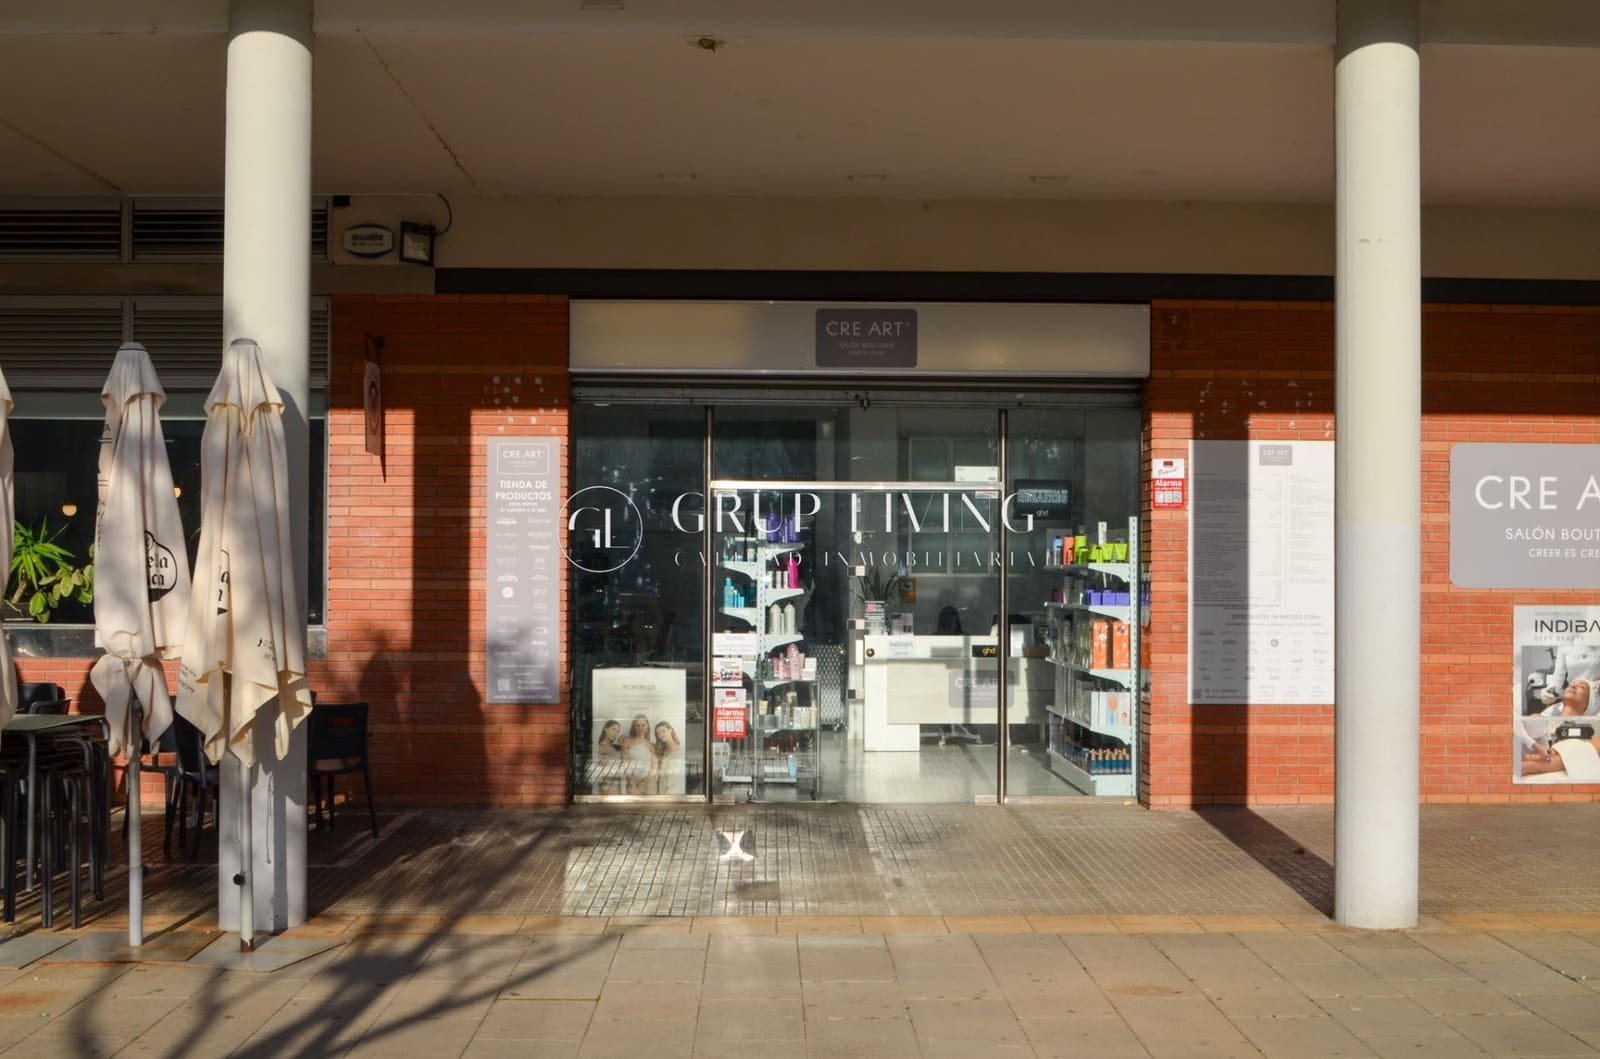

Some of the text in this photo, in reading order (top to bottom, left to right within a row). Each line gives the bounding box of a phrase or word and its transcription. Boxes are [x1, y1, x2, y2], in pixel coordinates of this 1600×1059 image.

[825, 320, 904, 336] CRE ART
[502, 449, 542, 458] CRE ART
[499, 480, 548, 489] TIENDA DE
[1154, 479, 1183, 487] Alarma
[495, 491, 552, 501] PRODUCTOS
[1474, 475, 1558, 510] CRE
[1505, 525, 1555, 540] SALÓN
[1528, 548, 1561, 558] CREER
[1564, 548, 1577, 558] ES
[982, 646, 997, 656] ghd
[716, 708, 745, 717] Alarma
